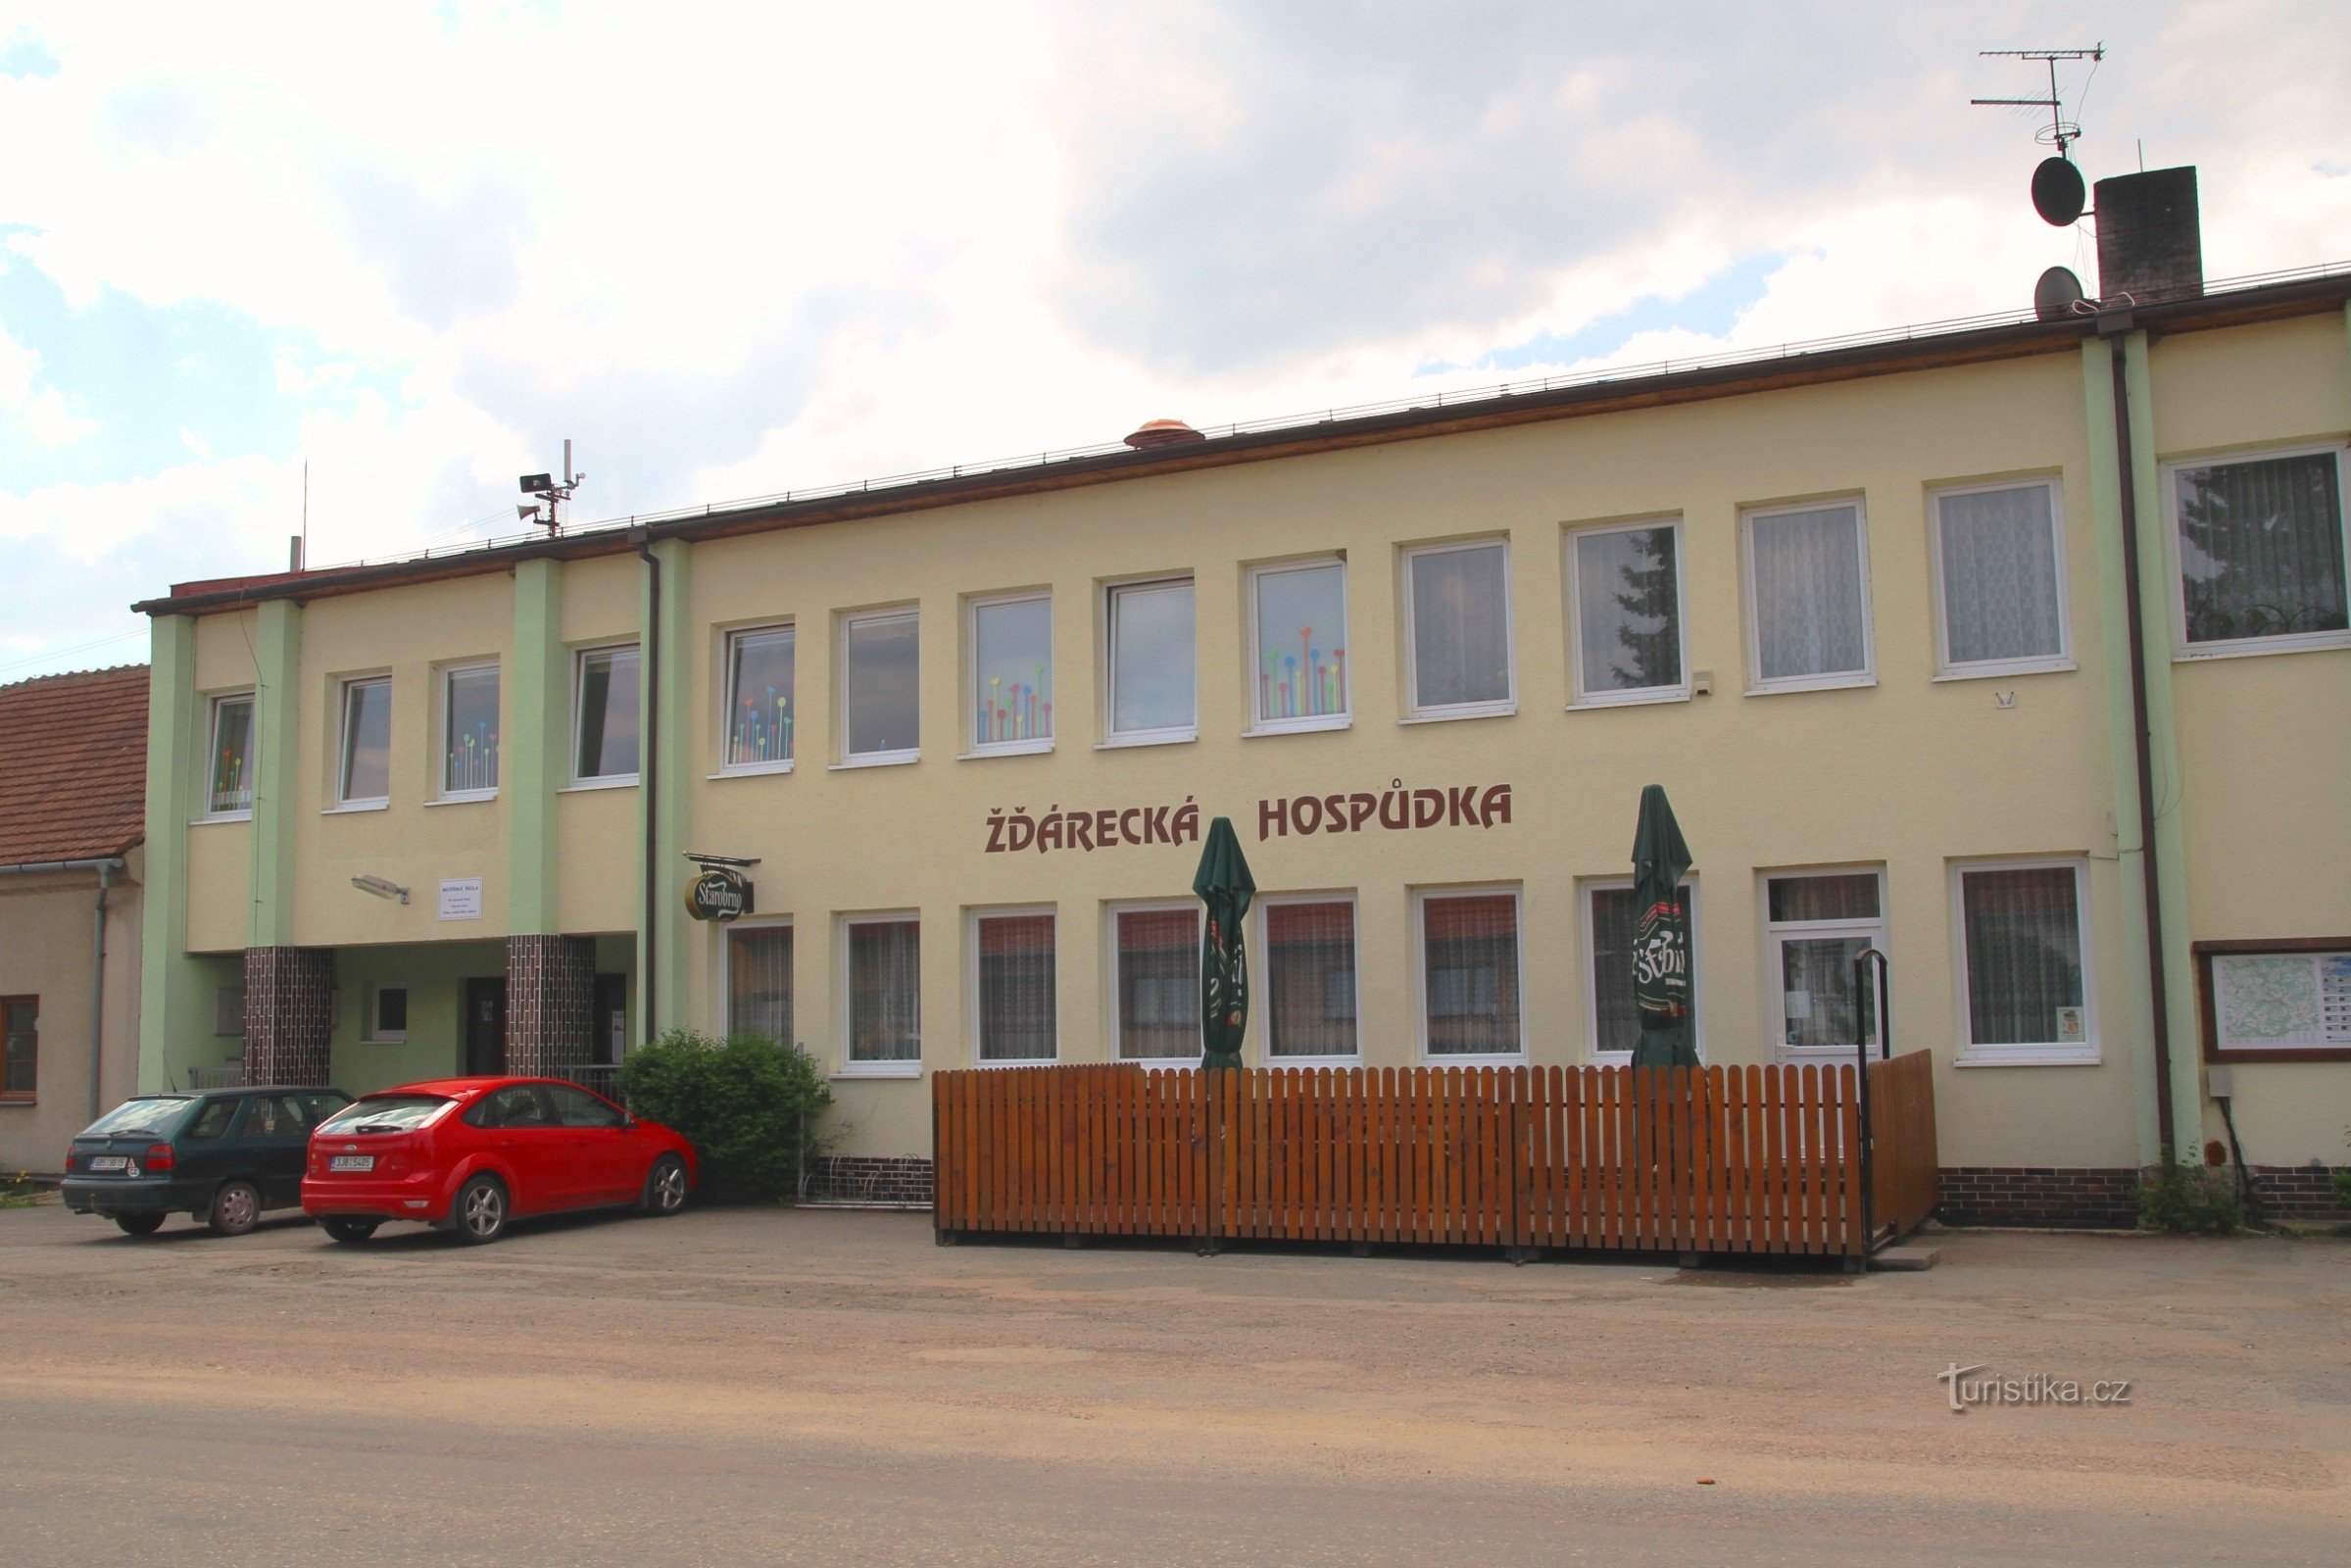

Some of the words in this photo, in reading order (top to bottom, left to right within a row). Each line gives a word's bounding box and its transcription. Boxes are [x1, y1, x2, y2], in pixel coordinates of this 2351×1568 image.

[984, 795, 1200, 855] ŽĎÁRECKÁ
[1258, 777, 1512, 843] HOSPŮDKA
[698, 881, 742, 916] Starobrno
